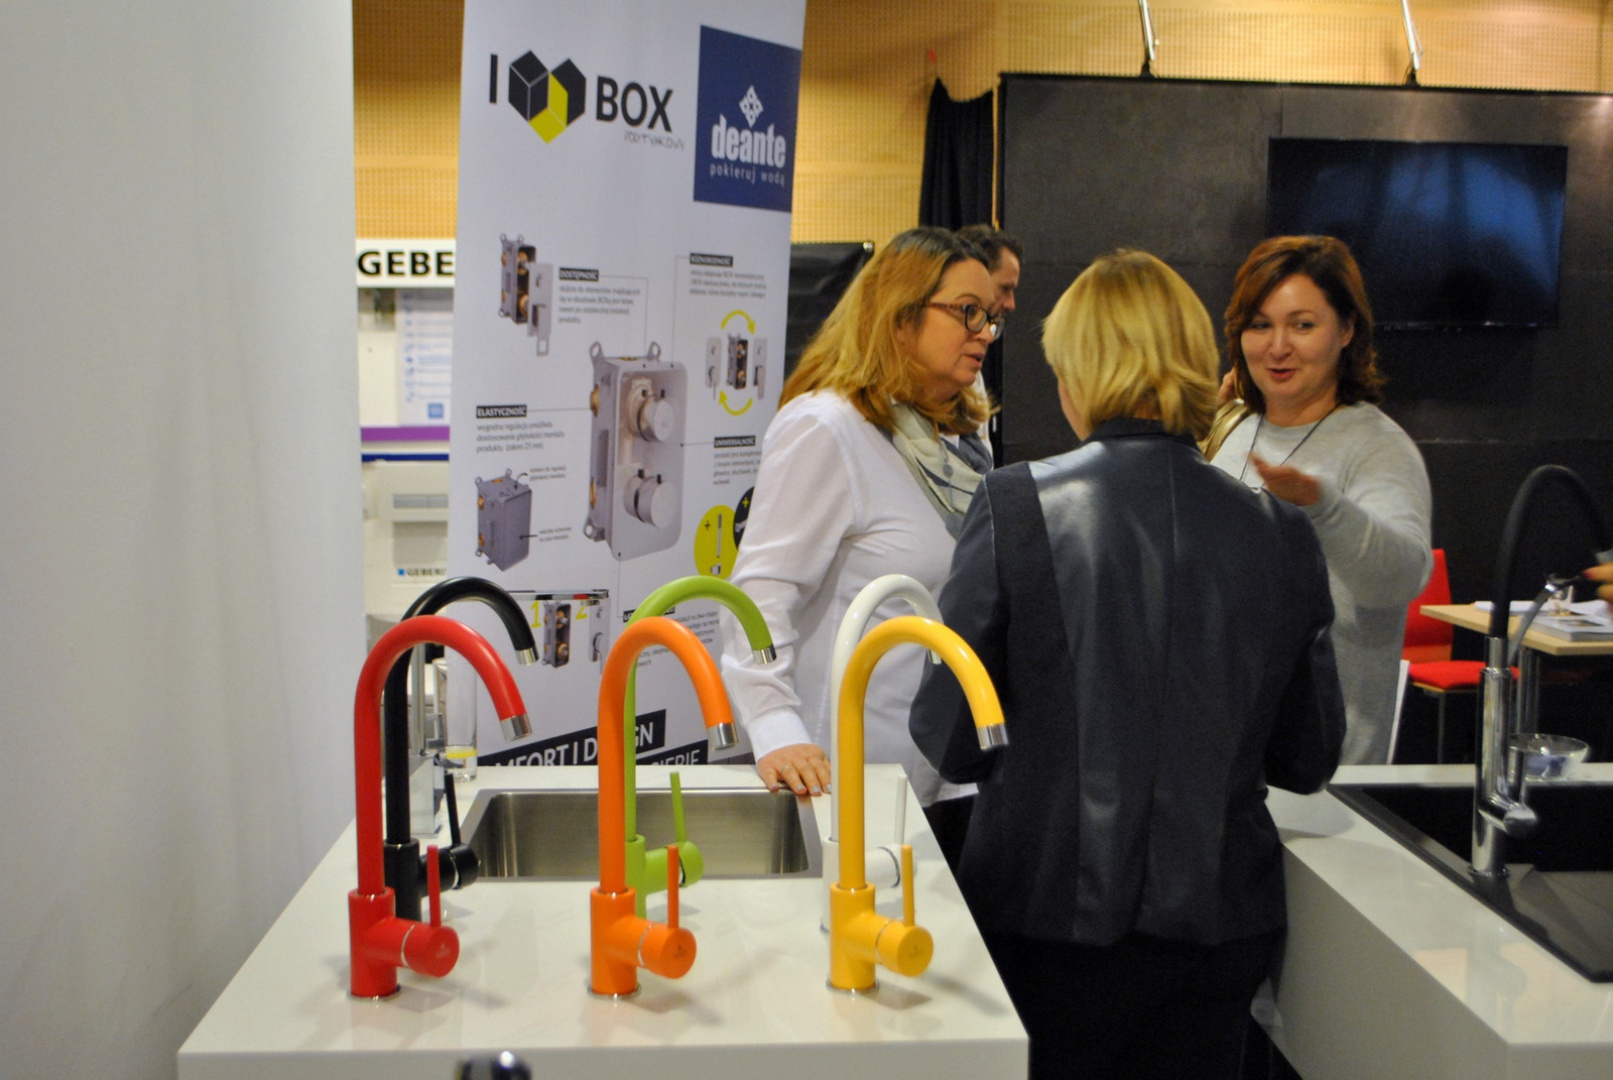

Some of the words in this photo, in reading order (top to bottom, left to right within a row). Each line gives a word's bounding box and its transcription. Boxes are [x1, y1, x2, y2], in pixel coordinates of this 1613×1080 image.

[596, 75, 673, 133] BOX
[711, 113, 786, 169] deante
[710, 163, 756, 185] pokieruj
[357, 251, 454, 277] GEBE
